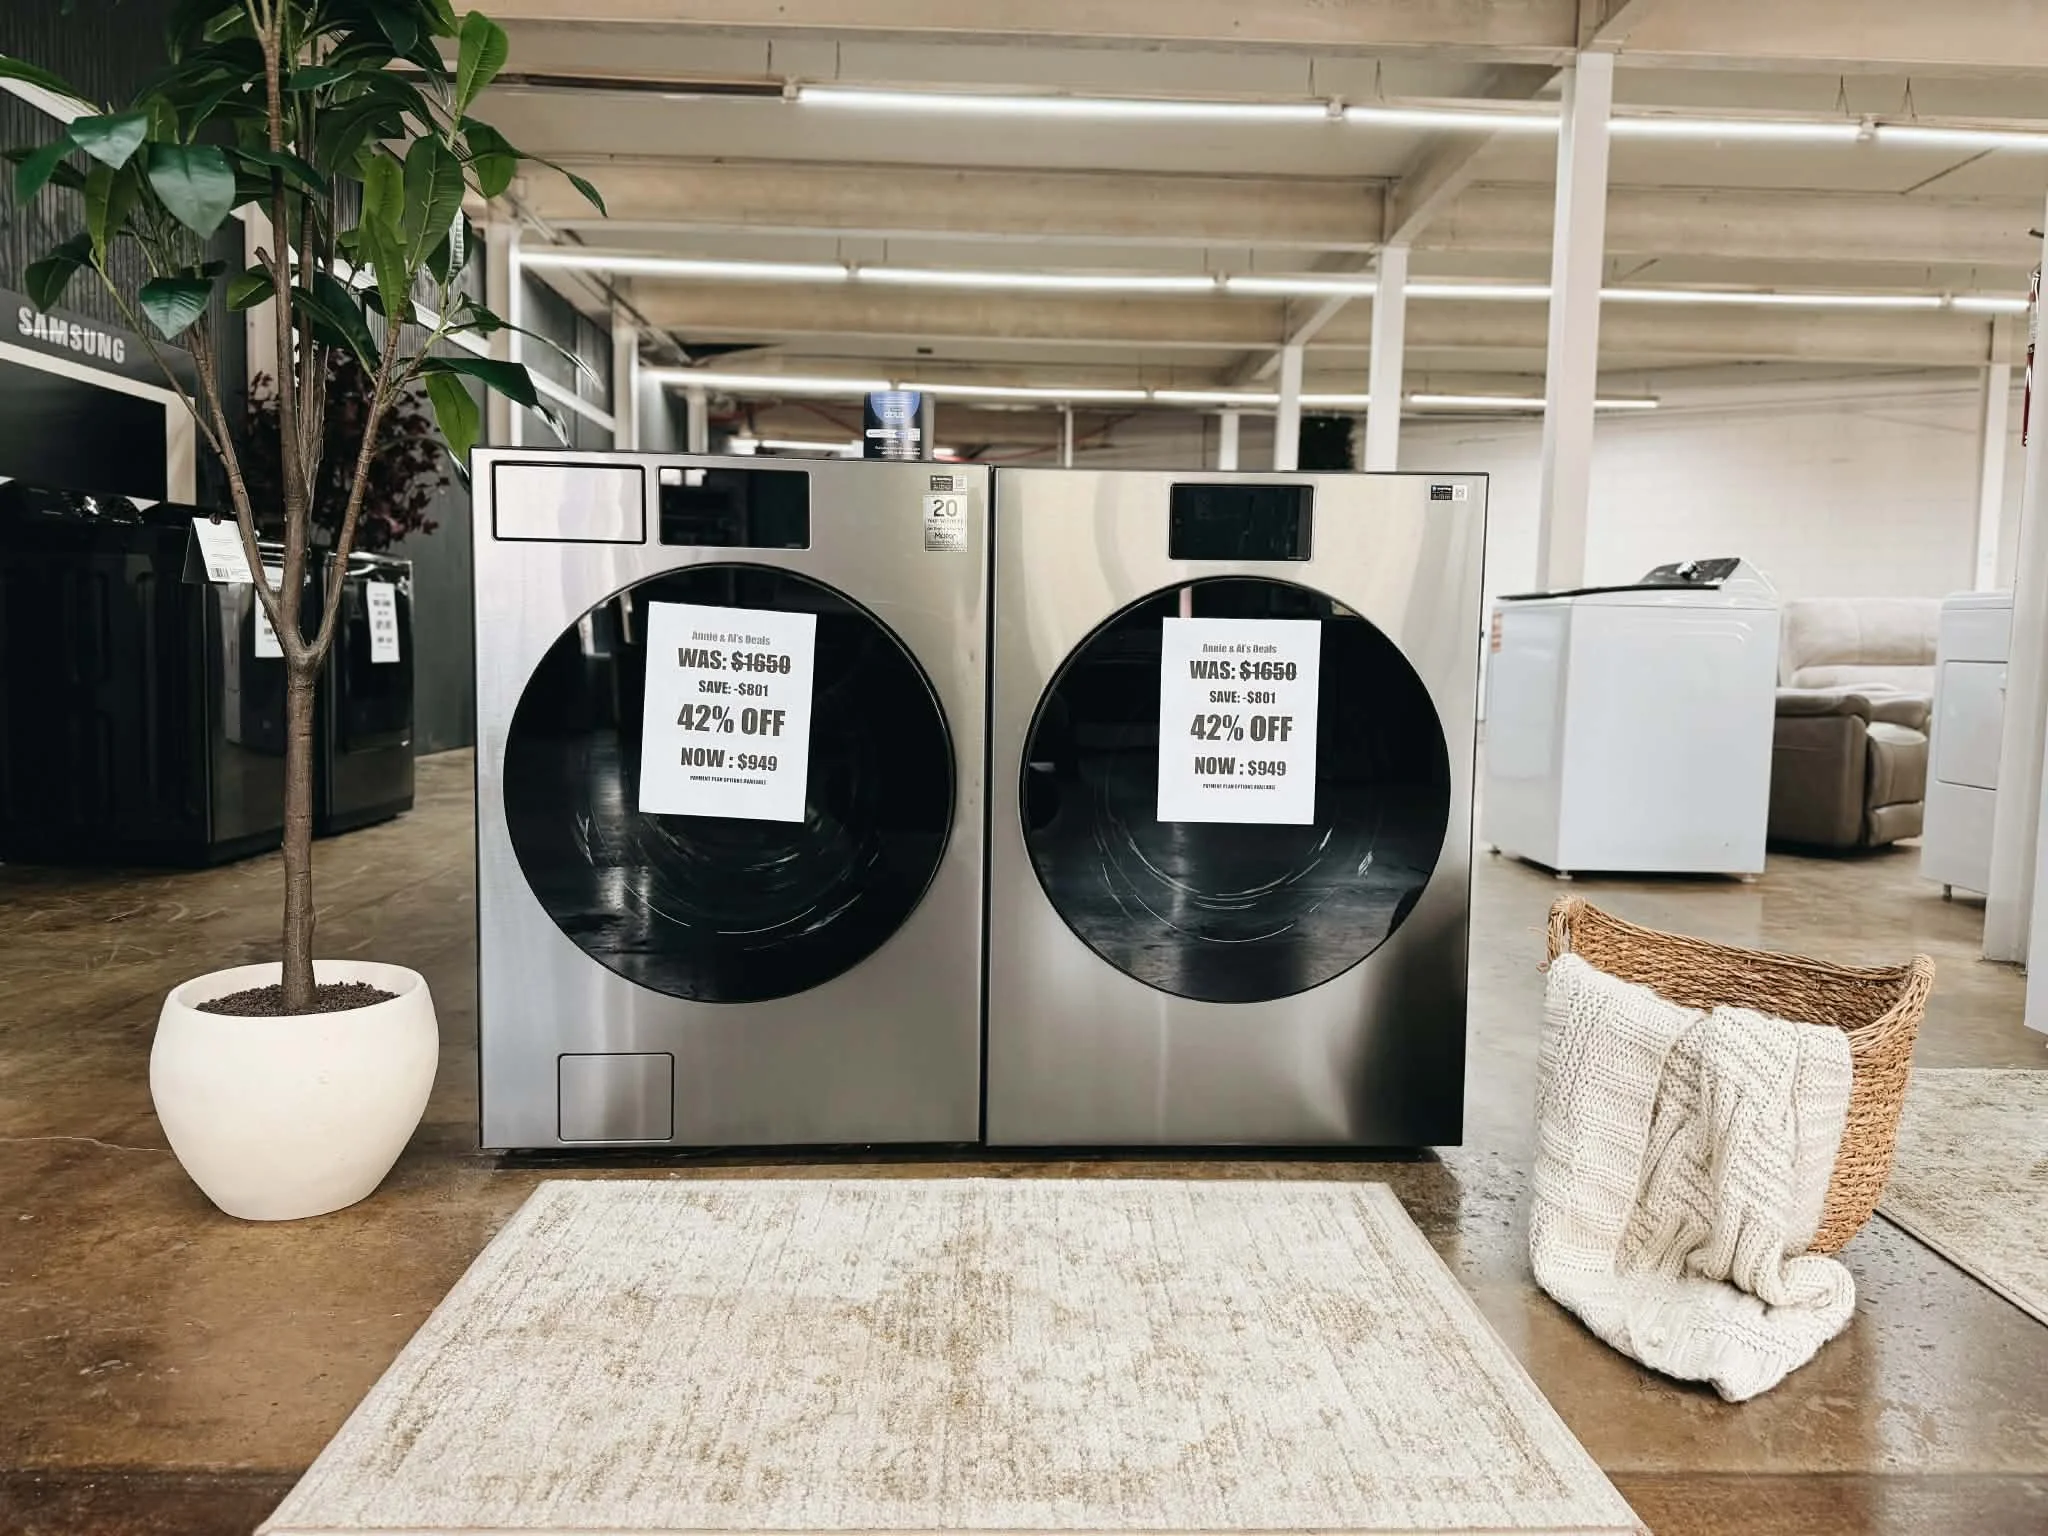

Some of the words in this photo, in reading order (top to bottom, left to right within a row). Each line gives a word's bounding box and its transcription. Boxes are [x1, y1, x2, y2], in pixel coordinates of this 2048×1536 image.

[18, 306, 125, 364] SAMSUNG
[933, 499, 958, 517] 20
[745, 635, 771, 646] Deals
[1202, 643, 1227, 653] Annie
[1253, 644, 1277, 654] Deals
[677, 647, 727, 671] WAS:
[731, 650, 791, 674] $1650
[1190, 660, 1235, 680] WAS:
[1239, 660, 1297, 682] $1650
[698, 680, 731, 694] SAVE:
[733, 682, 769, 697] -$801
[1209, 691, 1240, 704] SAVE:
[1242, 690, 1276, 705] -$801
[677, 703, 734, 734] 42%
[741, 708, 786, 737] OFF
[1190, 714, 1244, 742] 42%
[1250, 715, 1293, 742] OFF
[737, 752, 778, 772] $949
[1247, 760, 1287, 776] $949
